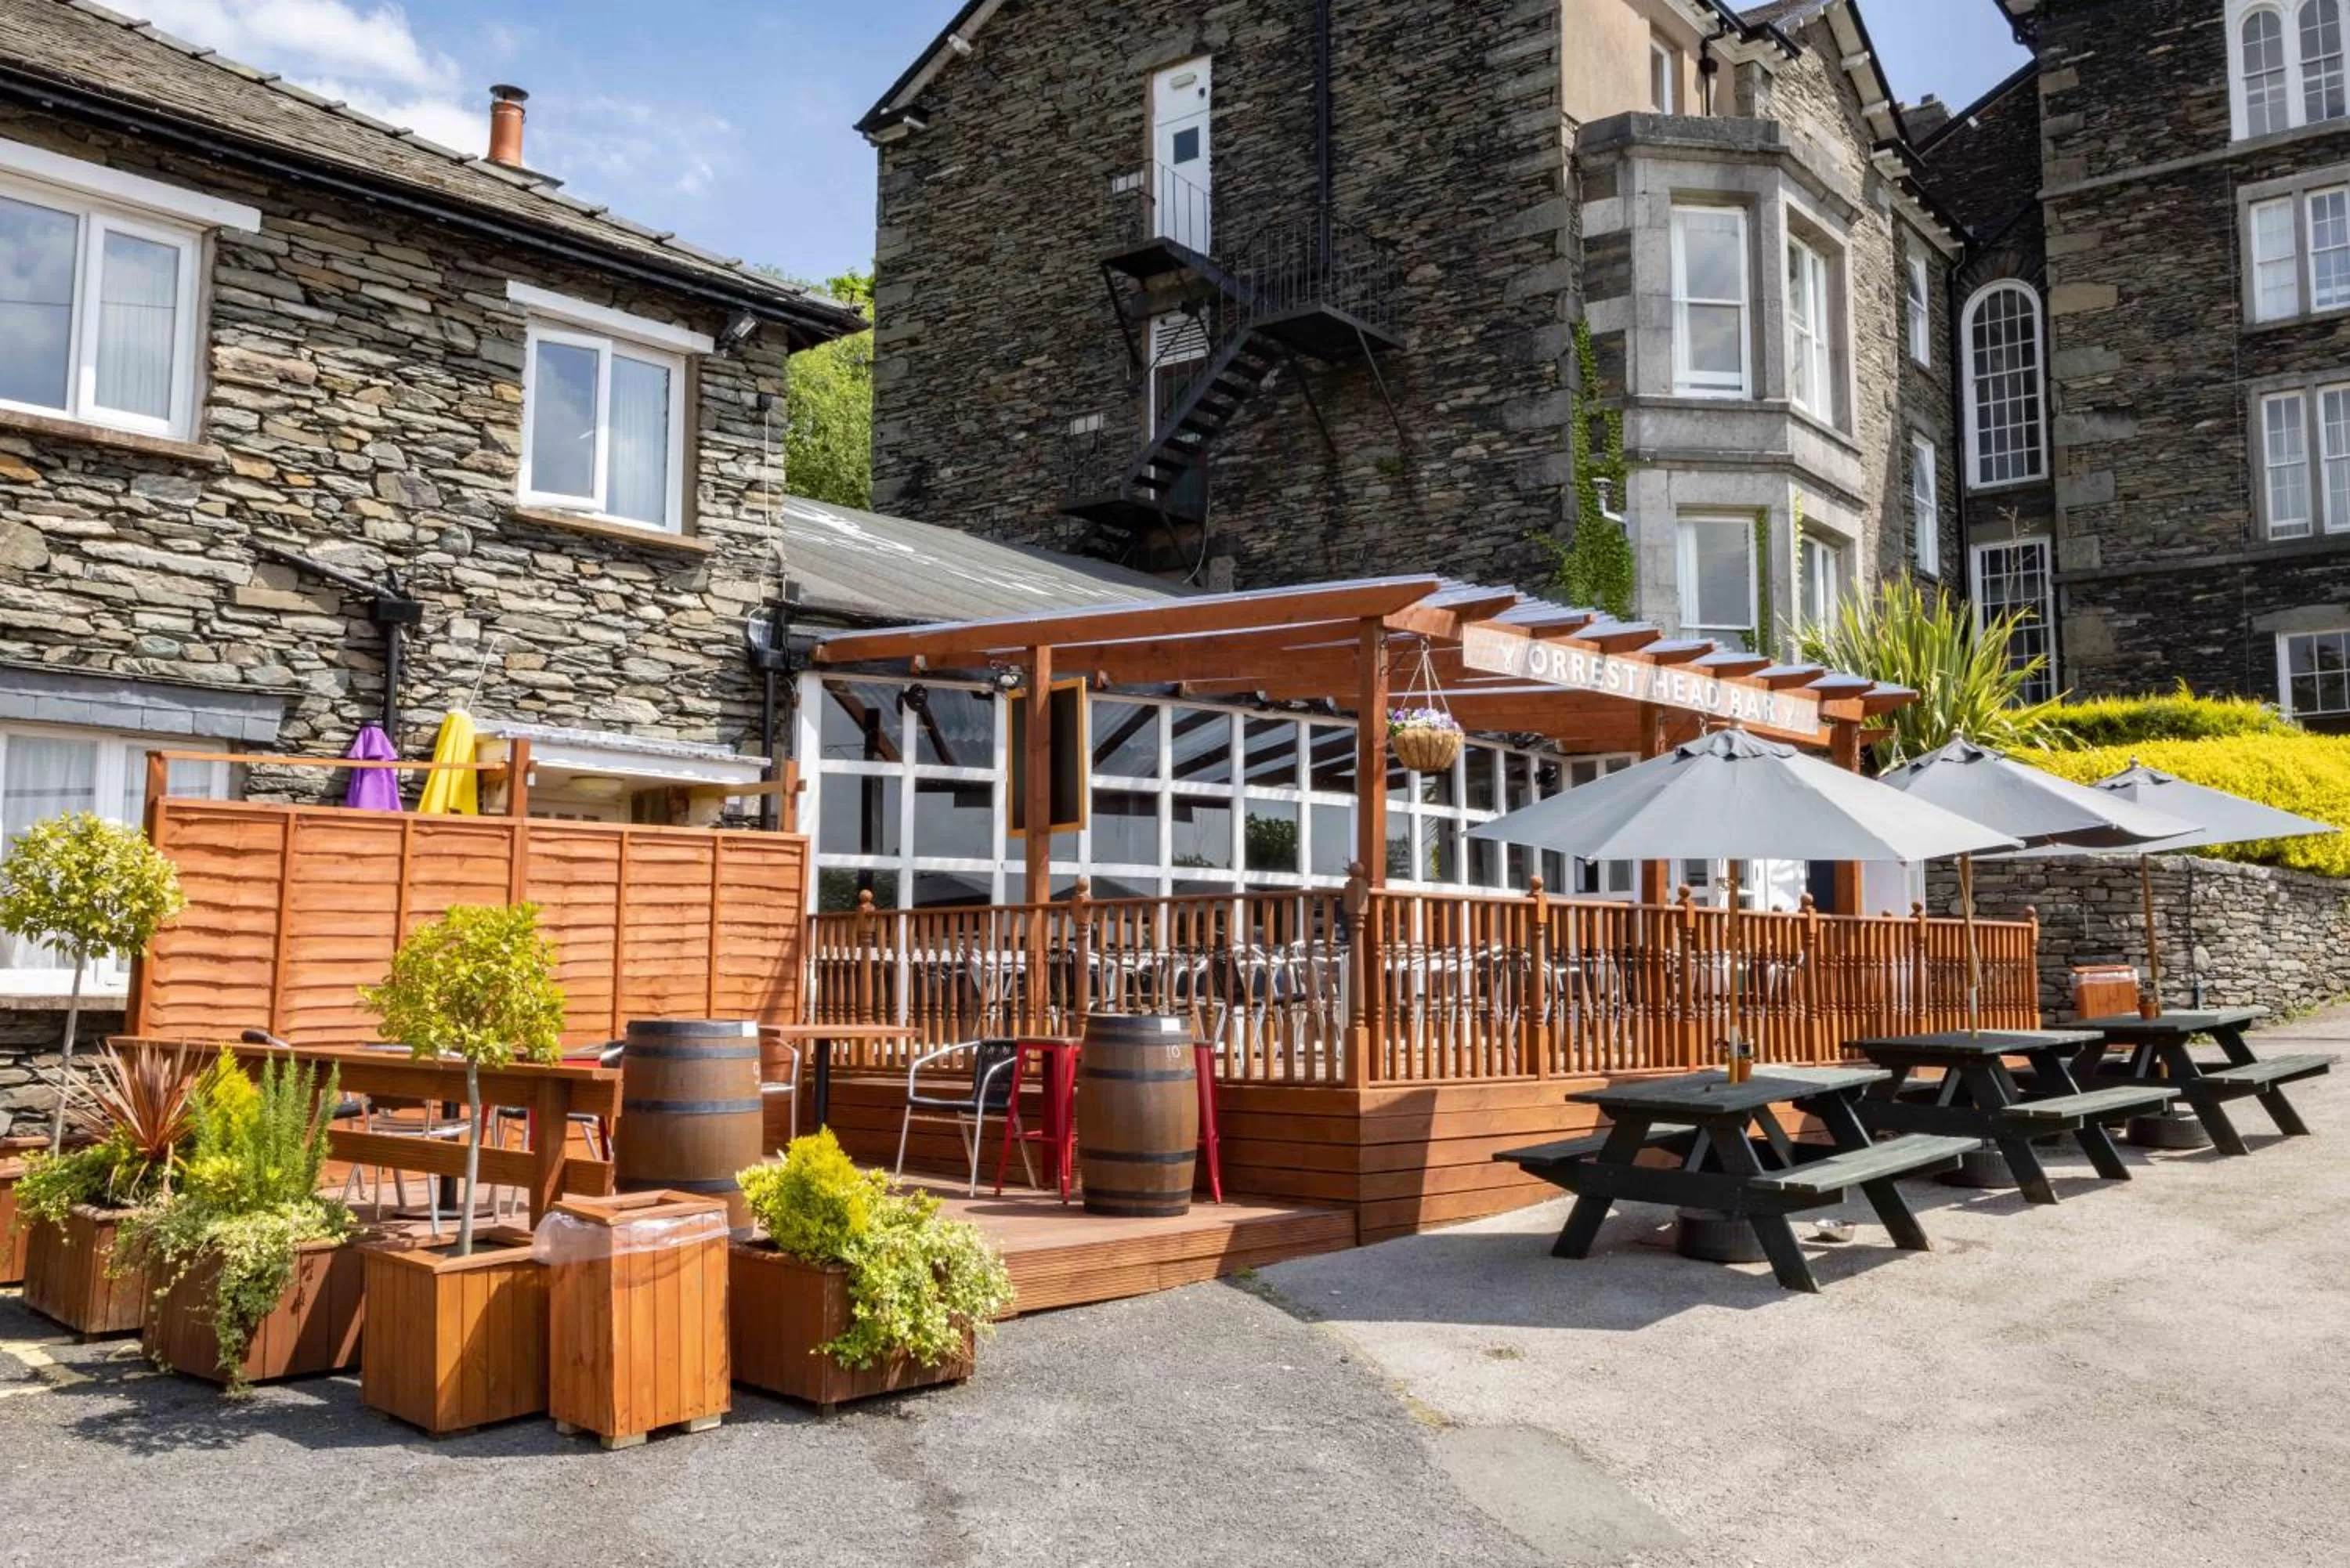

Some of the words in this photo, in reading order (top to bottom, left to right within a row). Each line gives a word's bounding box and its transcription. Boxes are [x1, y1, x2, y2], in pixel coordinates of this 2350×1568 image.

[1528, 645, 1638, 693] ORREST
[1652, 670, 1720, 710] HEAD
[1730, 687, 1776, 722] BAR
